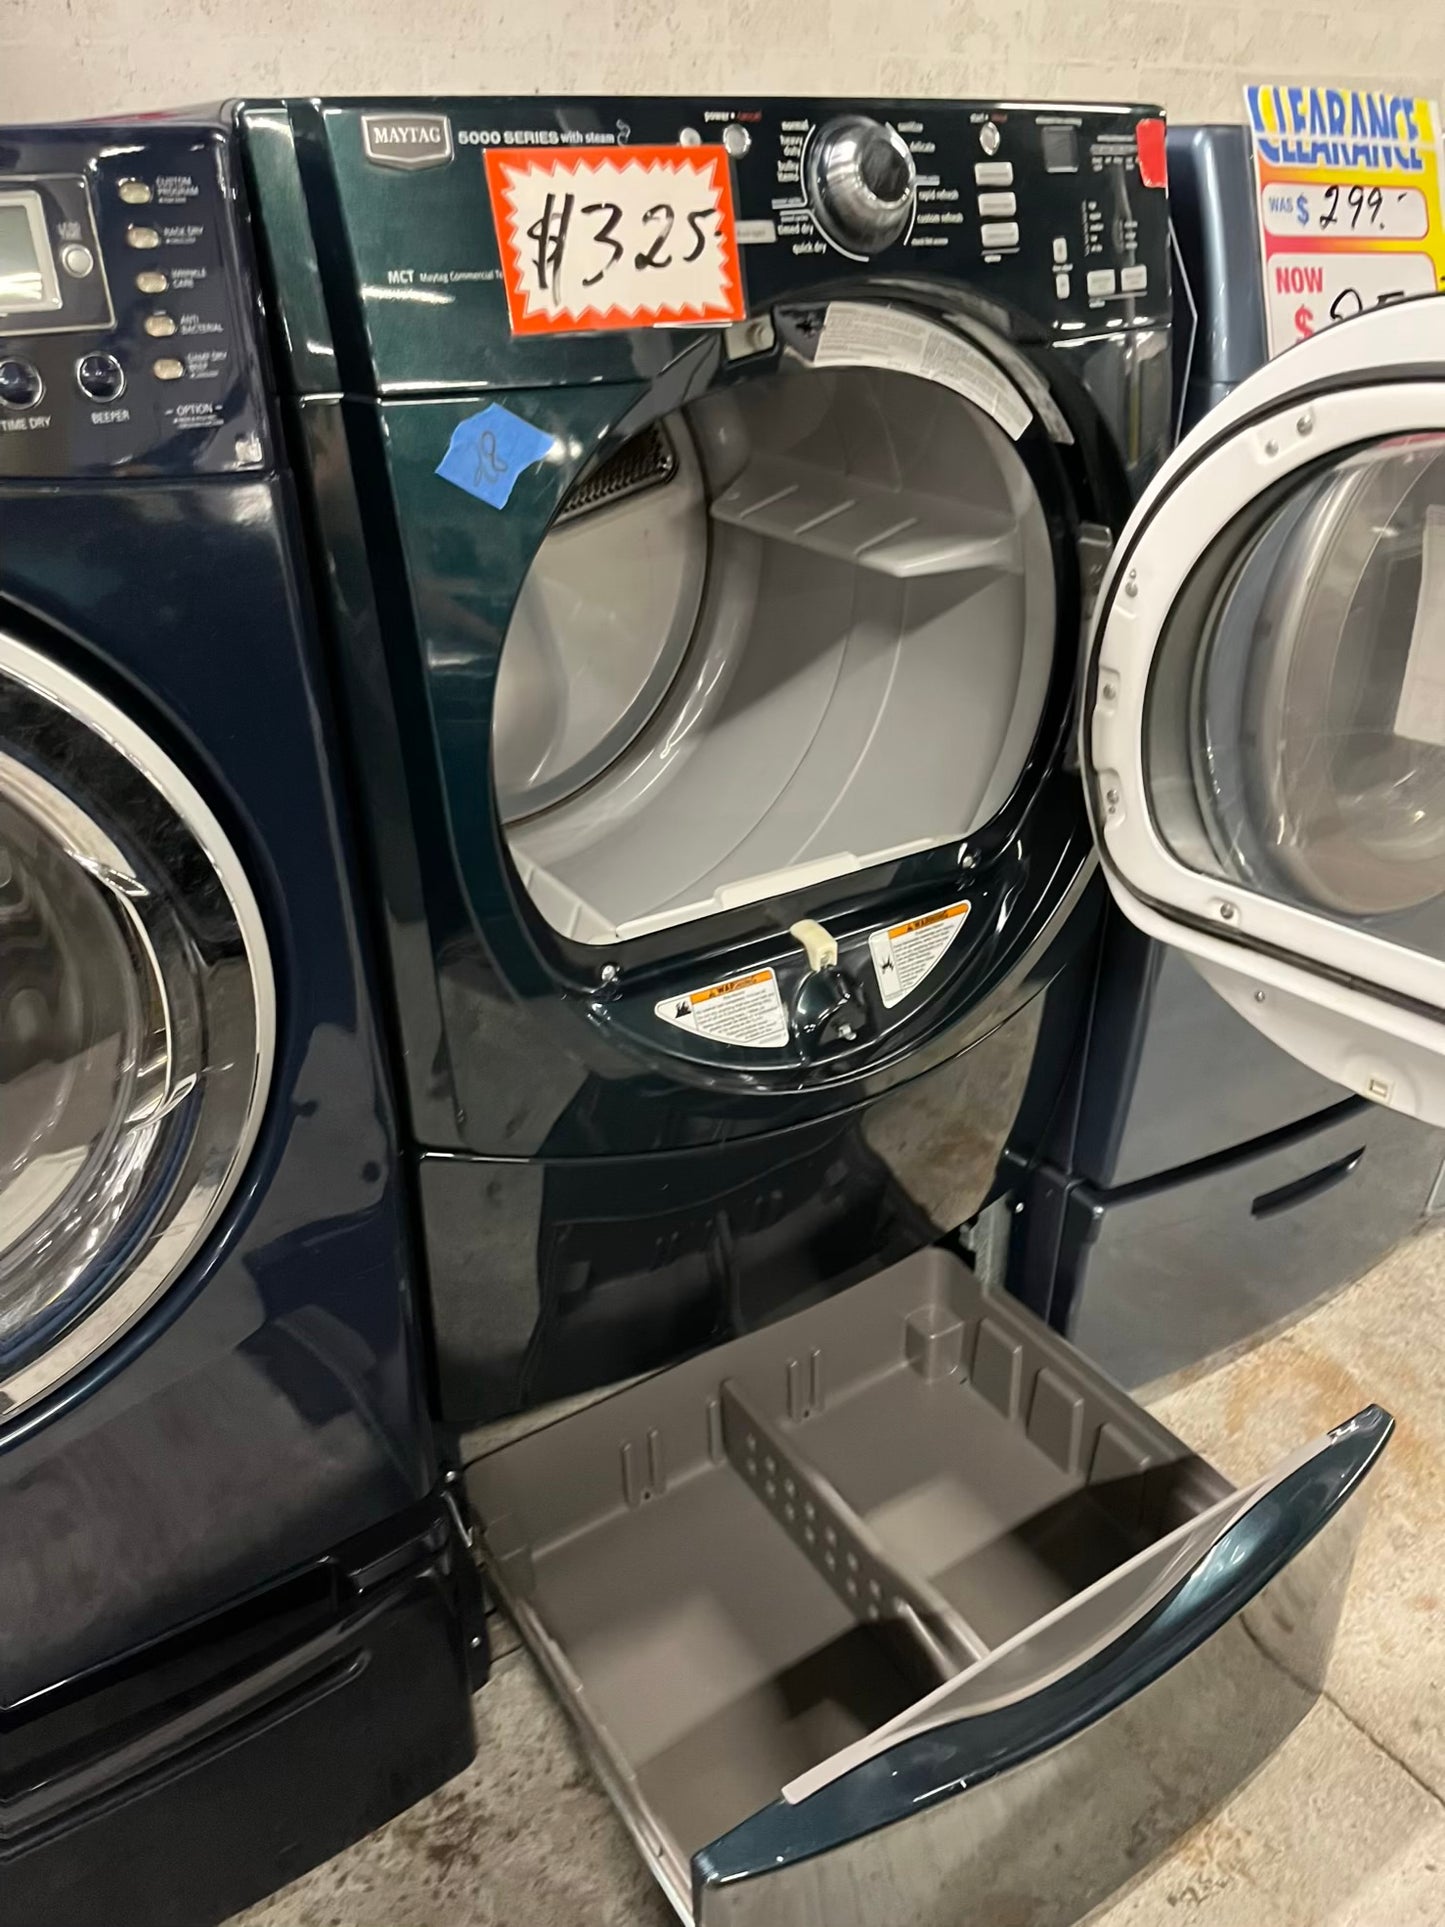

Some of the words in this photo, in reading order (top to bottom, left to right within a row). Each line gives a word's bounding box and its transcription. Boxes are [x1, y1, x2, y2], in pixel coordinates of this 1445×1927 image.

[1247, 84, 1422, 170] CLEARANCE
[374, 126, 441, 145] MAYTAG
[503, 131, 559, 145] SERIES
[561, 131, 583, 144] with
[585, 131, 615, 144] steam
[1268, 196, 1294, 213] WAS
[388, 270, 415, 284] MCT
[1275, 266, 1323, 294] NOW
[91, 409, 130, 424] BEEPER
[176, 402, 214, 416] OPTION
[28, 415, 52, 429] DRY
